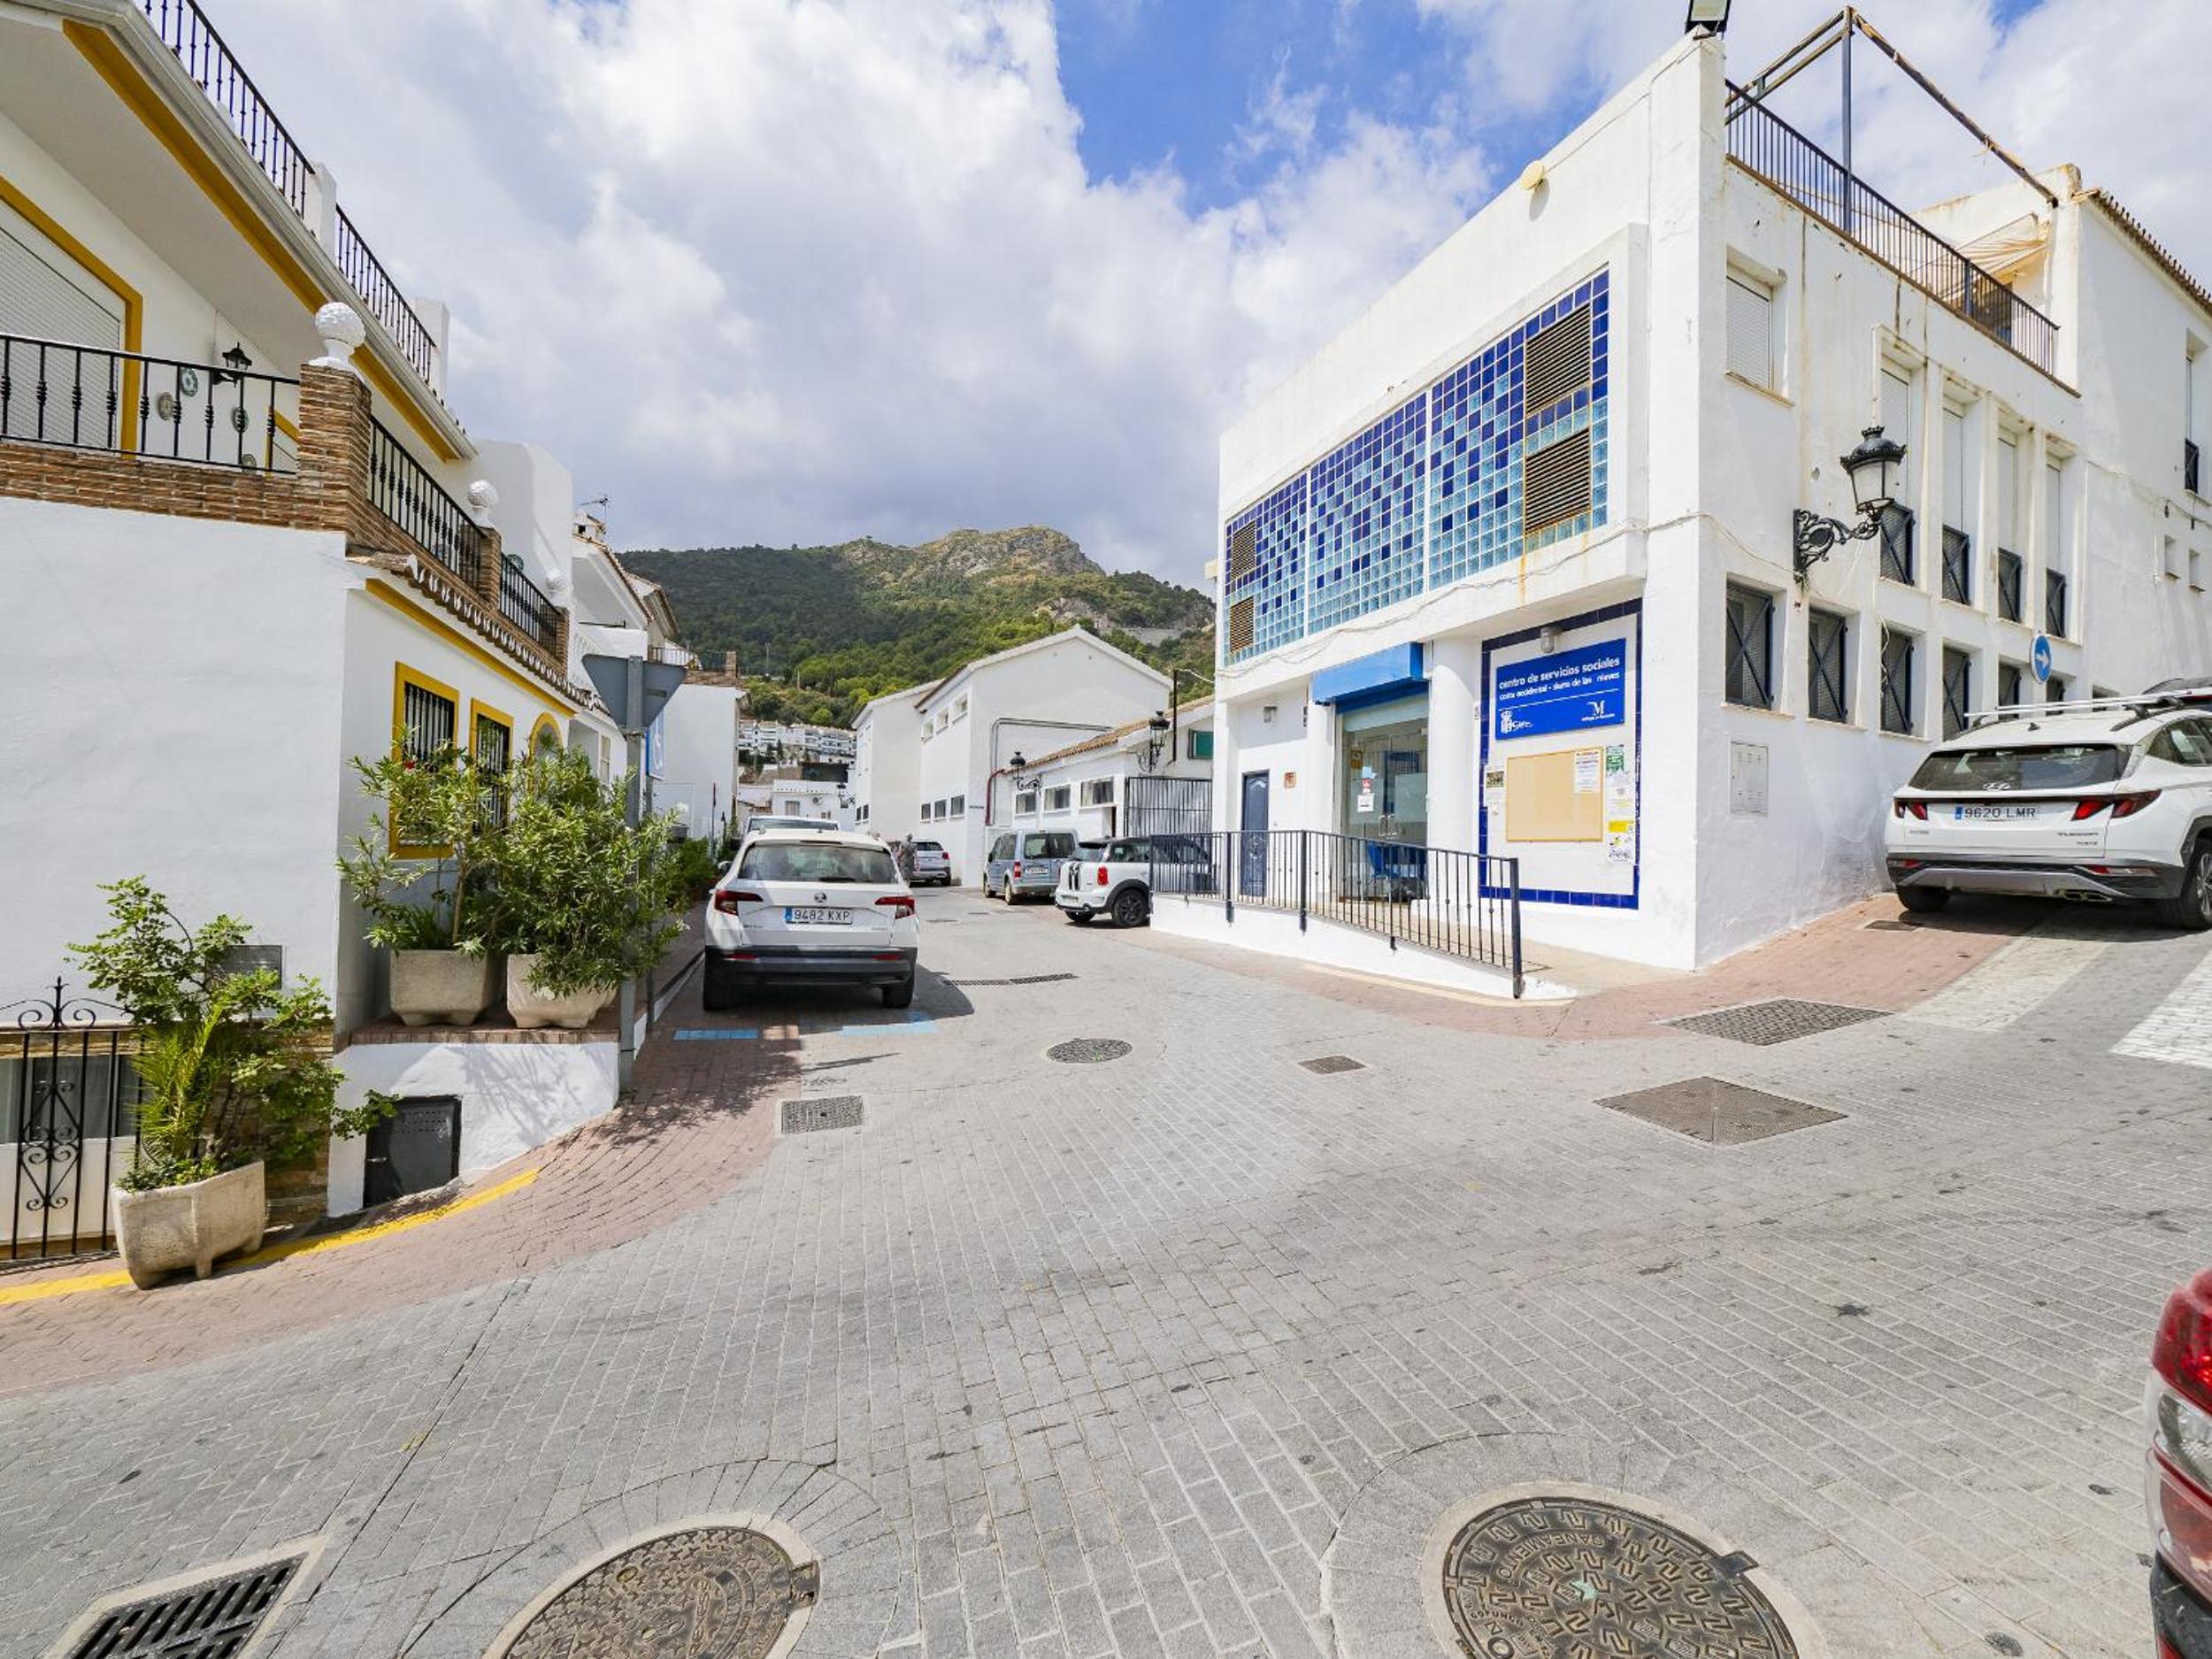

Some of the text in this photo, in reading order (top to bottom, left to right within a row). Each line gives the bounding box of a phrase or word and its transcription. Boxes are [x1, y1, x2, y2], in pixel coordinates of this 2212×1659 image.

[1499, 657, 1620, 689] centro de servicios sociales
[1964, 807, 2036, 818] 9620 LMR
[794, 910, 850, 921] 9482 KXP
[1497, 1532, 1605, 1579] SANEAMIENTO
